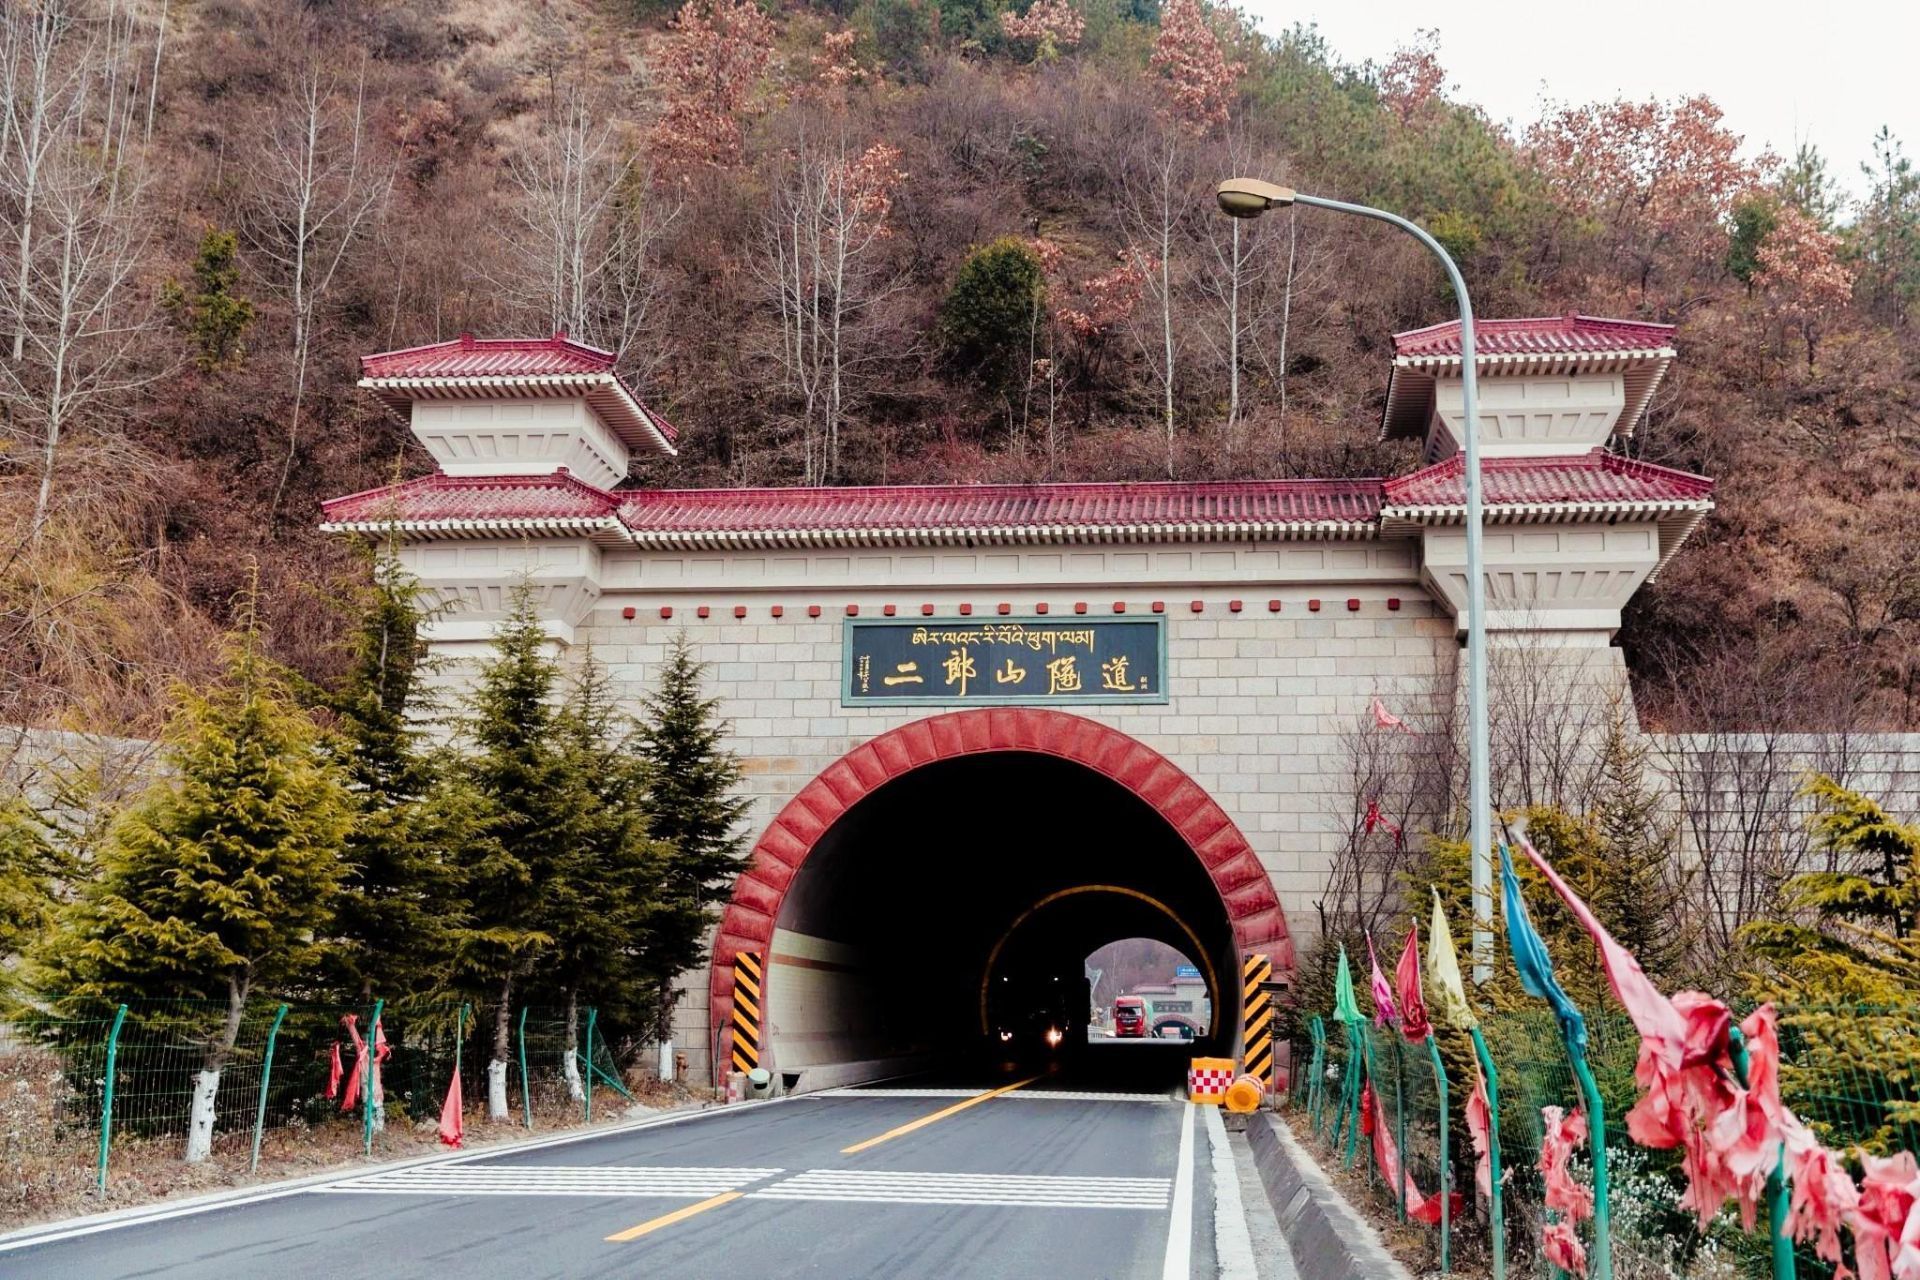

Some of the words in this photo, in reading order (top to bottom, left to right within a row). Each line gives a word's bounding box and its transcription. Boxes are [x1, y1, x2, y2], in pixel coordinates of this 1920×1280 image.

[884, 647, 1136, 696] 二郎山隧道
